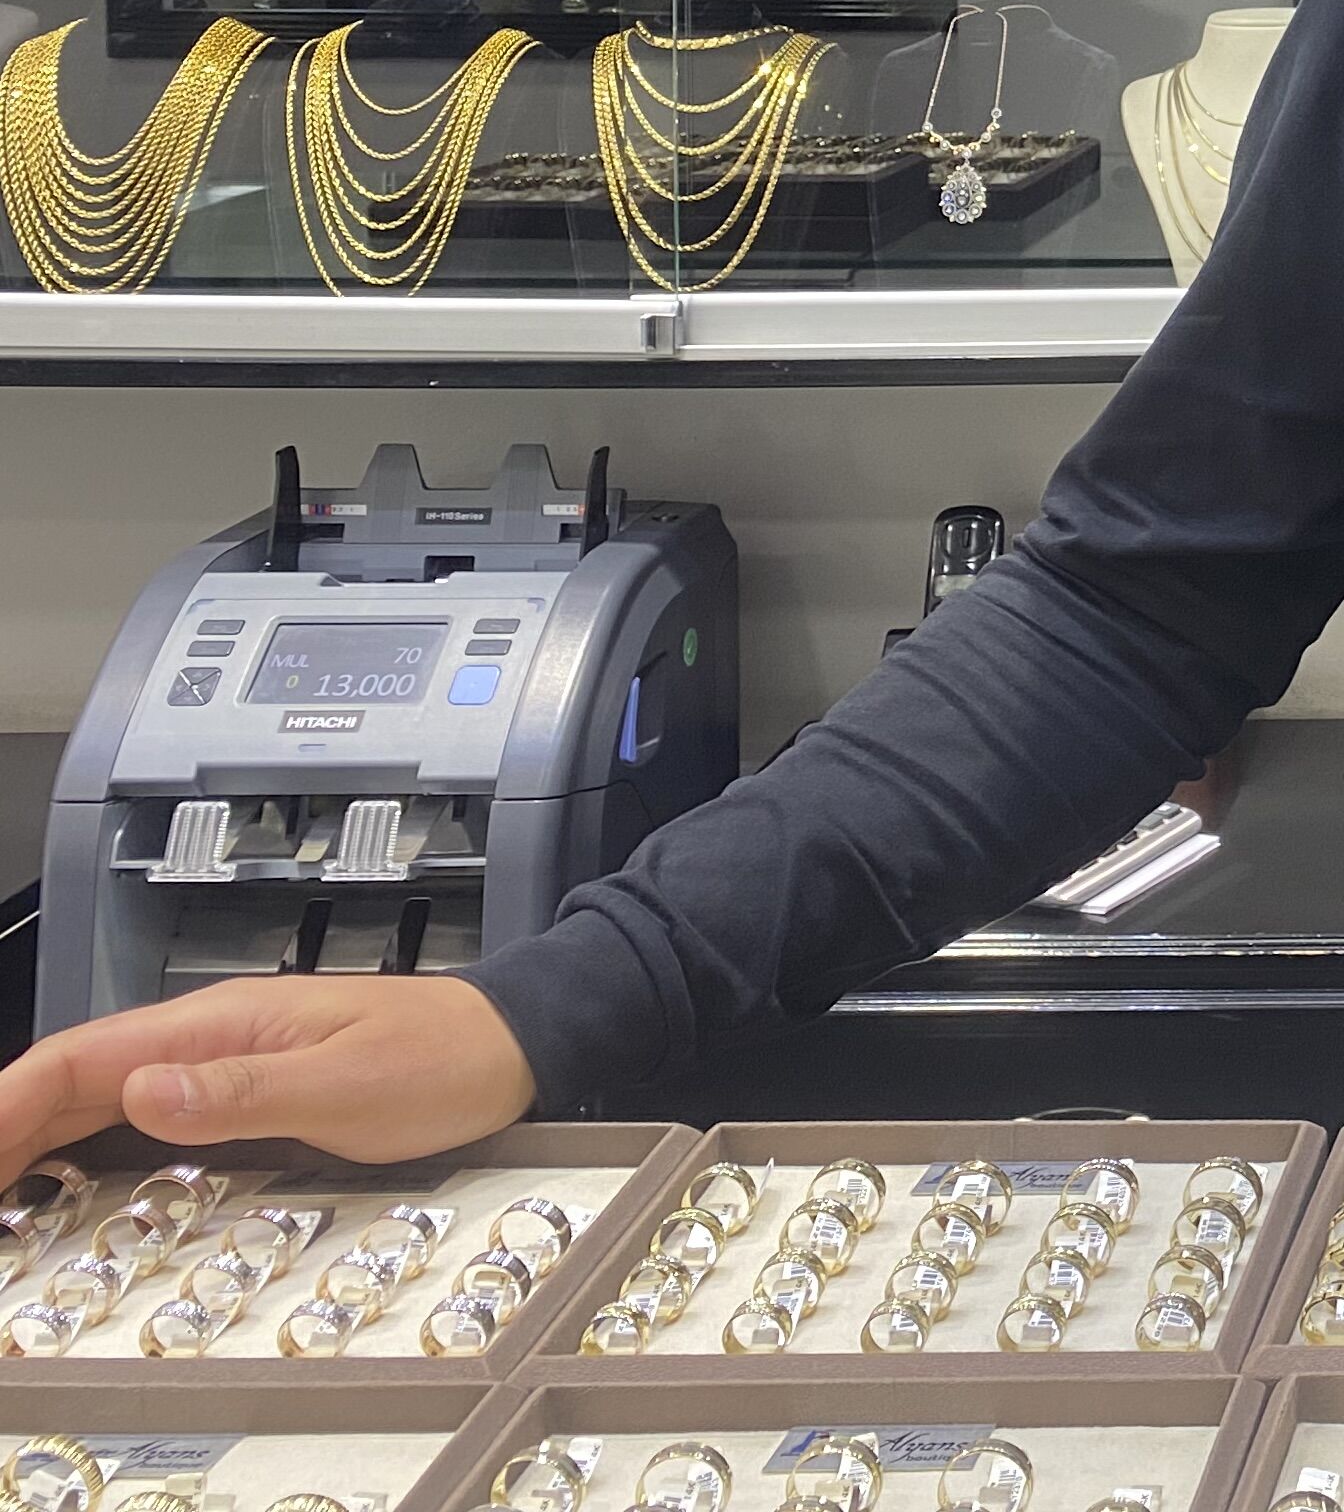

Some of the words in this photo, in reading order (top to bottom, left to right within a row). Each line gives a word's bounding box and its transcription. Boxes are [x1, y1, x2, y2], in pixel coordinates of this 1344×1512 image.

[393, 647, 422, 664] 70
[313, 673, 416, 698] 13,000
[286, 716, 358, 729] HITACHI
